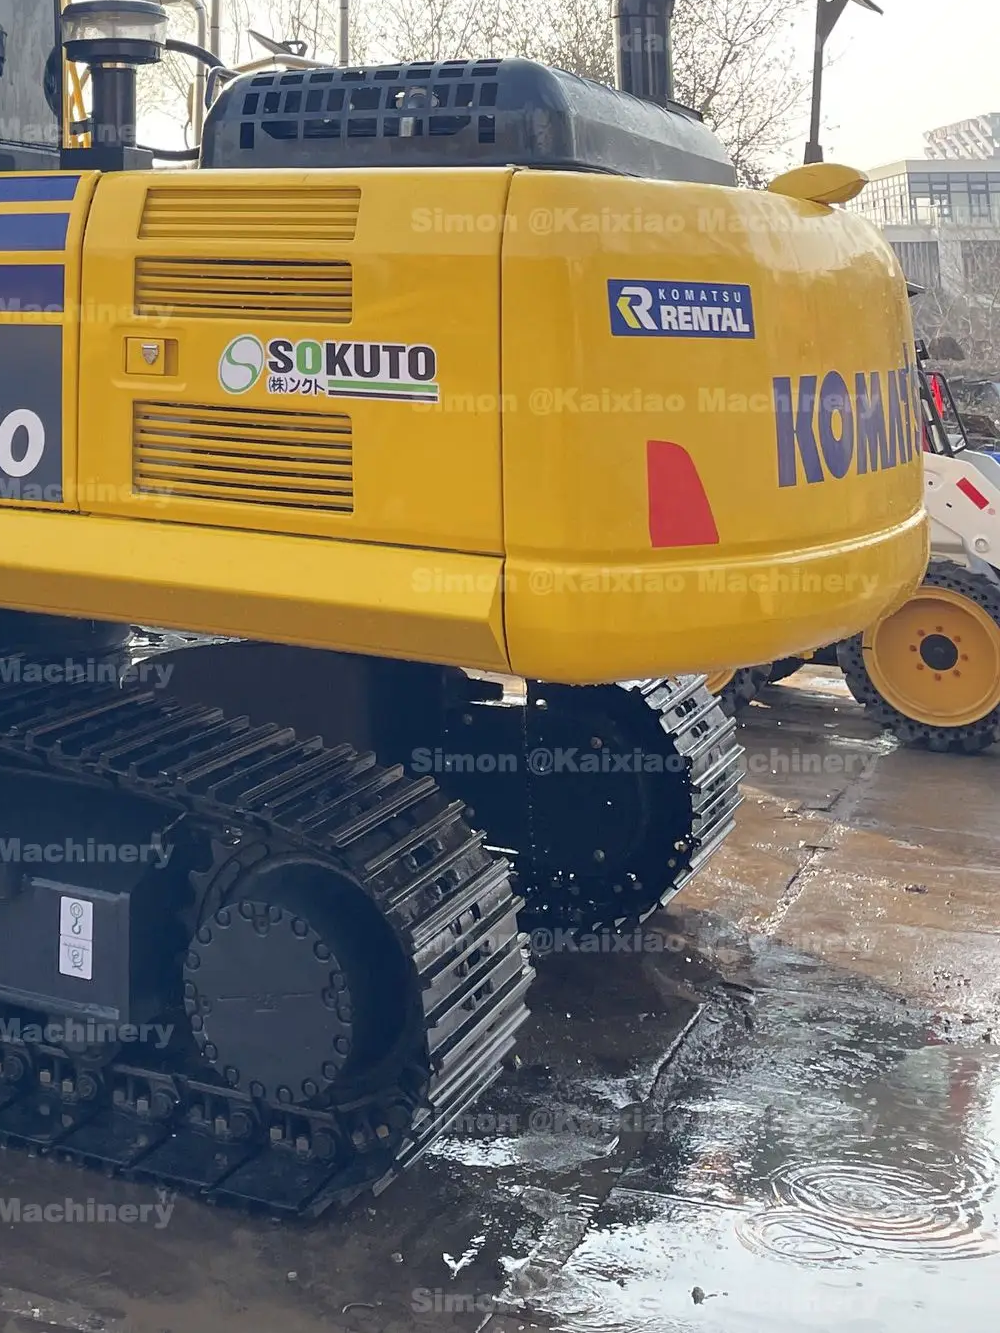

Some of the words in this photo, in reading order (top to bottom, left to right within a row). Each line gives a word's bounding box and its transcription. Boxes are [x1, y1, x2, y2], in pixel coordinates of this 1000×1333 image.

[658, 288, 741, 303] KOMATSU
[659, 305, 750, 333] RENTAL
[268, 340, 435, 381] SOKUTO
[773, 342, 922, 488] KOMAT
